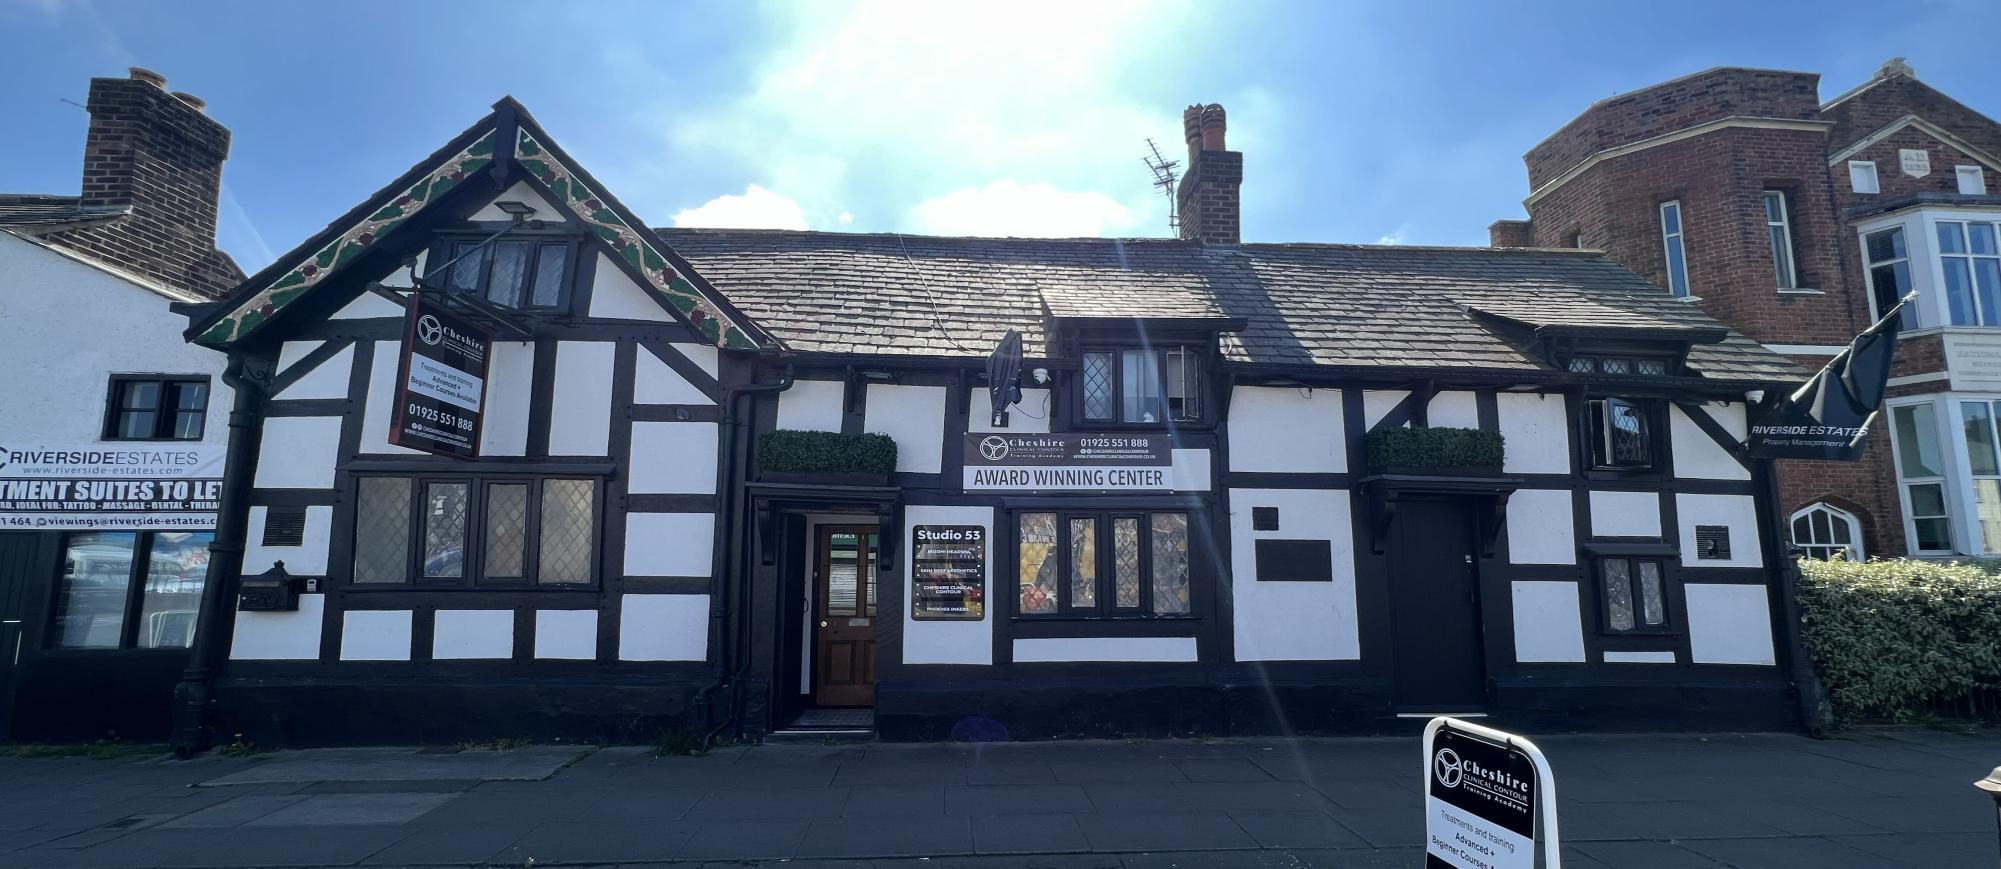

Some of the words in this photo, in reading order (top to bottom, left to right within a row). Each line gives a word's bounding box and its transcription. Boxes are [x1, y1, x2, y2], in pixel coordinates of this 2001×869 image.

[443, 326, 485, 352] Cheshire
[432, 376, 457, 389] Advanced
[409, 404, 438, 422] 01925
[440, 412, 456, 426] 551
[458, 418, 473, 432] 888
[1752, 426, 1808, 434] RIVERSIDE
[1808, 426, 1868, 436] ESTATES
[1080, 438, 1110, 447] 01925
[1112, 438, 1128, 447] 551
[1130, 438, 1148, 447] 888
[10, 451, 198, 465] RIVERSIDEESTATES
[23, 466, 183, 474] www.riverside-estates.com
[974, 470, 1030, 486] AWARD
[1034, 470, 1104, 486] WINNING
[1108, 470, 1162, 486] CENTER
[74, 480, 155, 500] SUITES
[160, 480, 189, 500] TO
[16, 502, 41, 510] IDEAL
[42, 502, 62, 510] FOR:
[62, 502, 96, 510] TATTOO
[102, 502, 146, 510] MASSAGE
[152, 502, 184, 510] DENTAL
[10, 518, 32, 526] 464
[918, 530, 962, 540] Studio
[965, 530, 980, 540] 53
[1463, 760, 1528, 792] Cheshire
[1463, 773, 1492, 790] CLINICAL
[1494, 784, 1528, 802] CONTOUR
[1463, 782, 1491, 800] Training
[1494, 796, 1527, 814] Academy
[1441, 810, 1473, 832] Treatments
[1474, 827, 1487, 838] and
[1488, 835, 1514, 854] training
[1432, 835, 1459, 855] Beginner
[1460, 850, 1488, 869] Courses
[1456, 832, 1488, 855] Advanced
